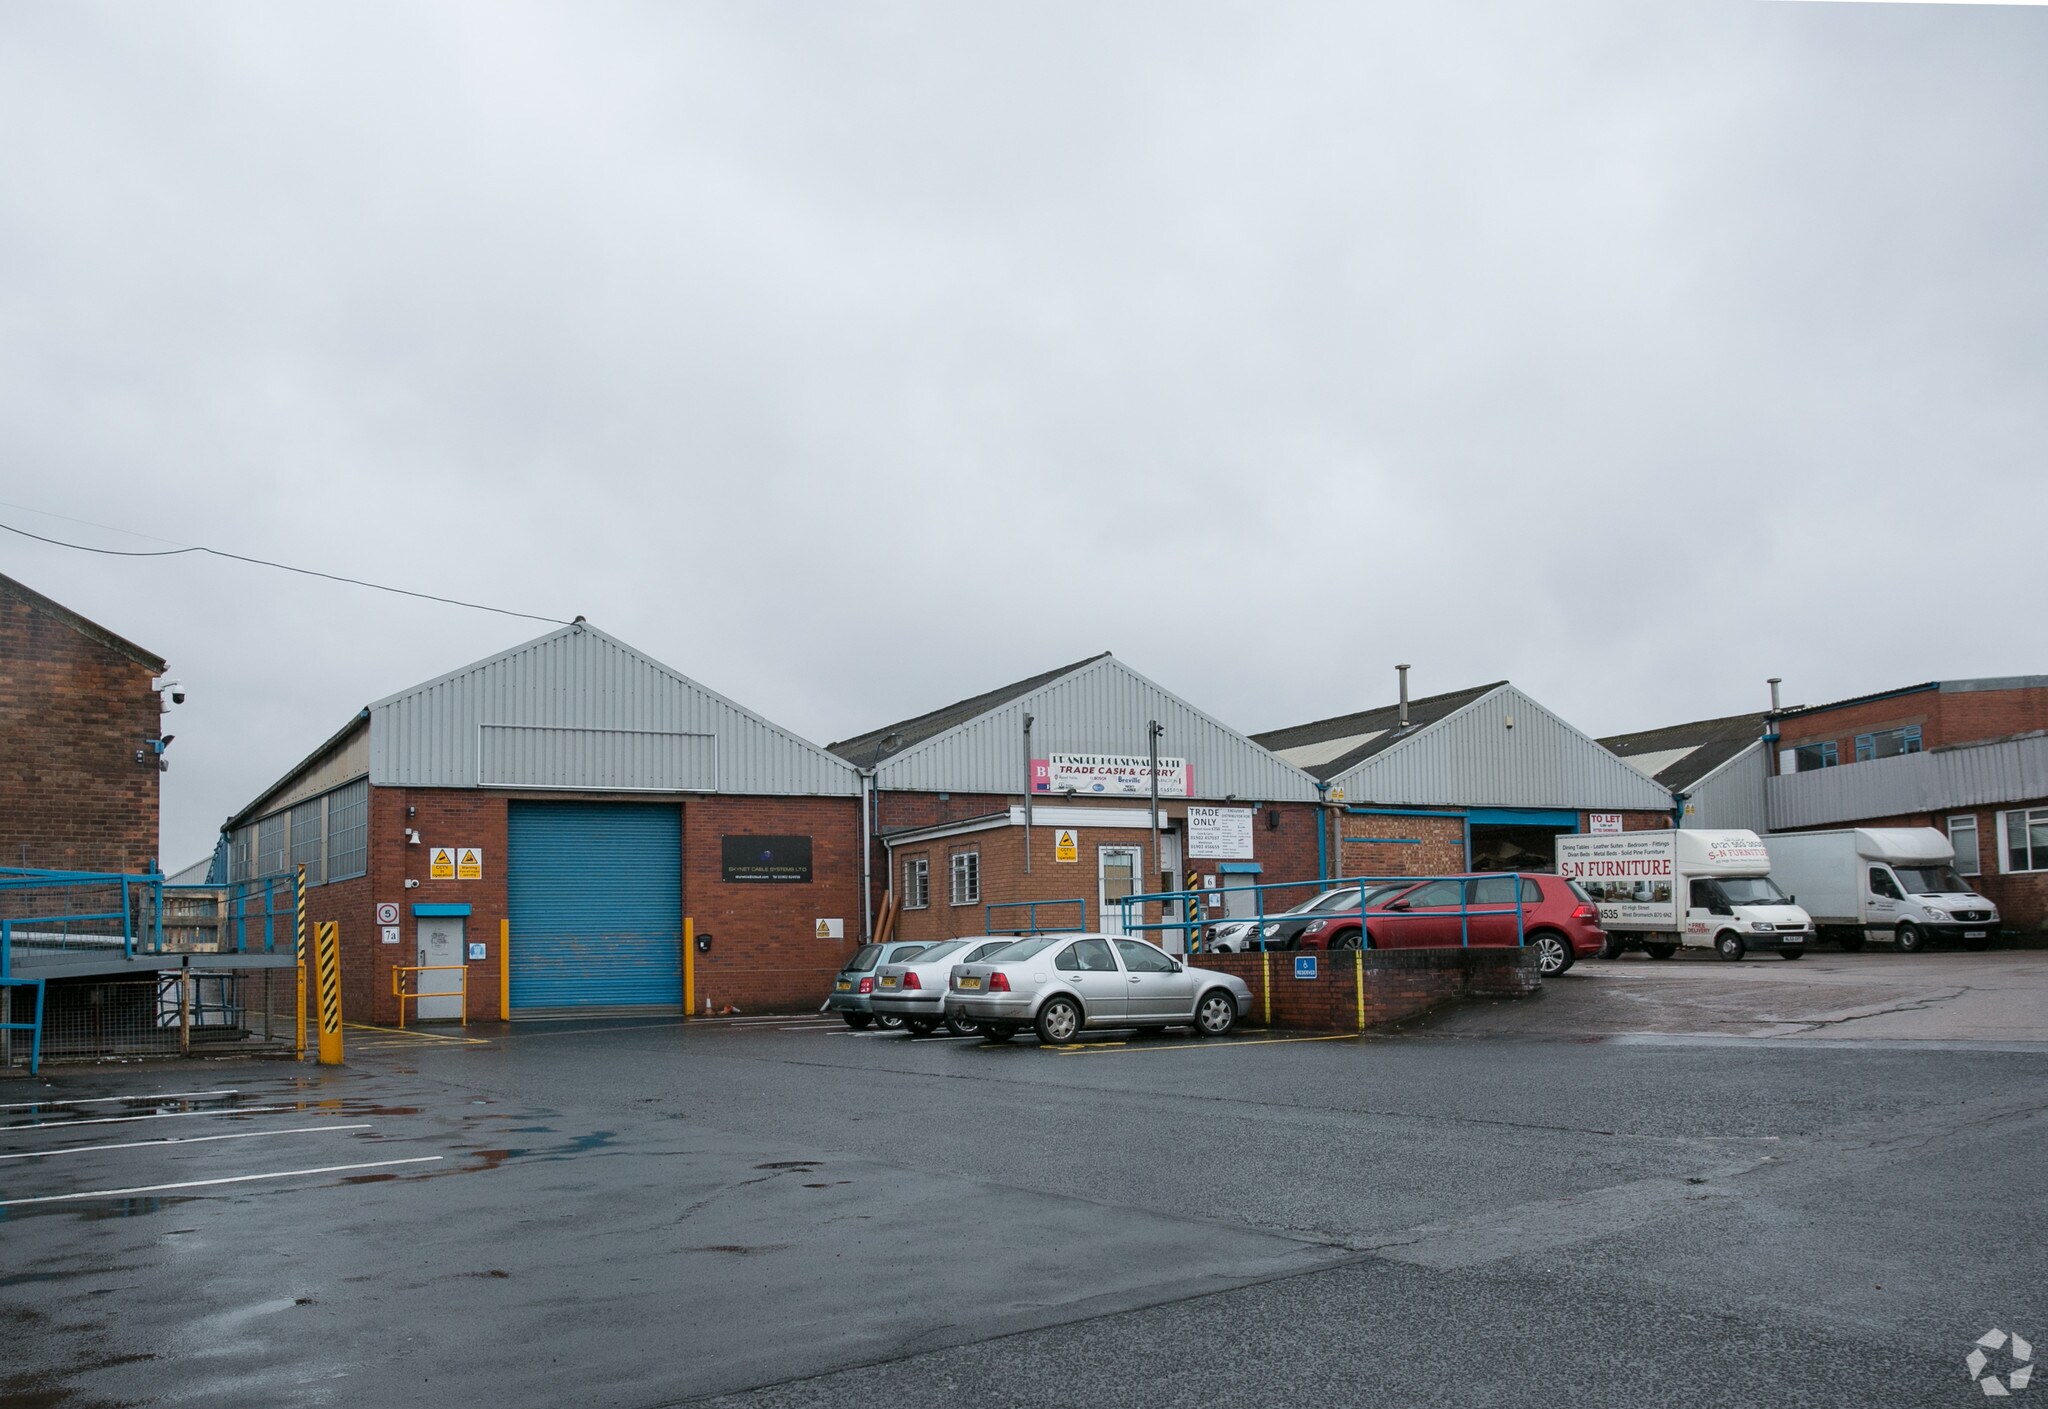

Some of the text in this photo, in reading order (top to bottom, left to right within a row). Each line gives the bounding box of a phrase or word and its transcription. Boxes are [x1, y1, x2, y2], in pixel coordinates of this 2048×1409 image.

[1101, 757, 1164, 768] HOUSEWARS
[1060, 765, 1176, 777] TRADE CASH & CARRY
[1118, 776, 1141, 784] Breville
[1190, 807, 1220, 817] TRADE
[1193, 818, 1216, 826] ONLY
[1591, 815, 1621, 823] TO LET
[1708, 849, 1727, 860] S-N
[1561, 859, 1672, 877] S-N FURNITURE
[1207, 878, 1213, 886] 6
[384, 909, 391, 918] 5
[385, 930, 397, 940] 7a
